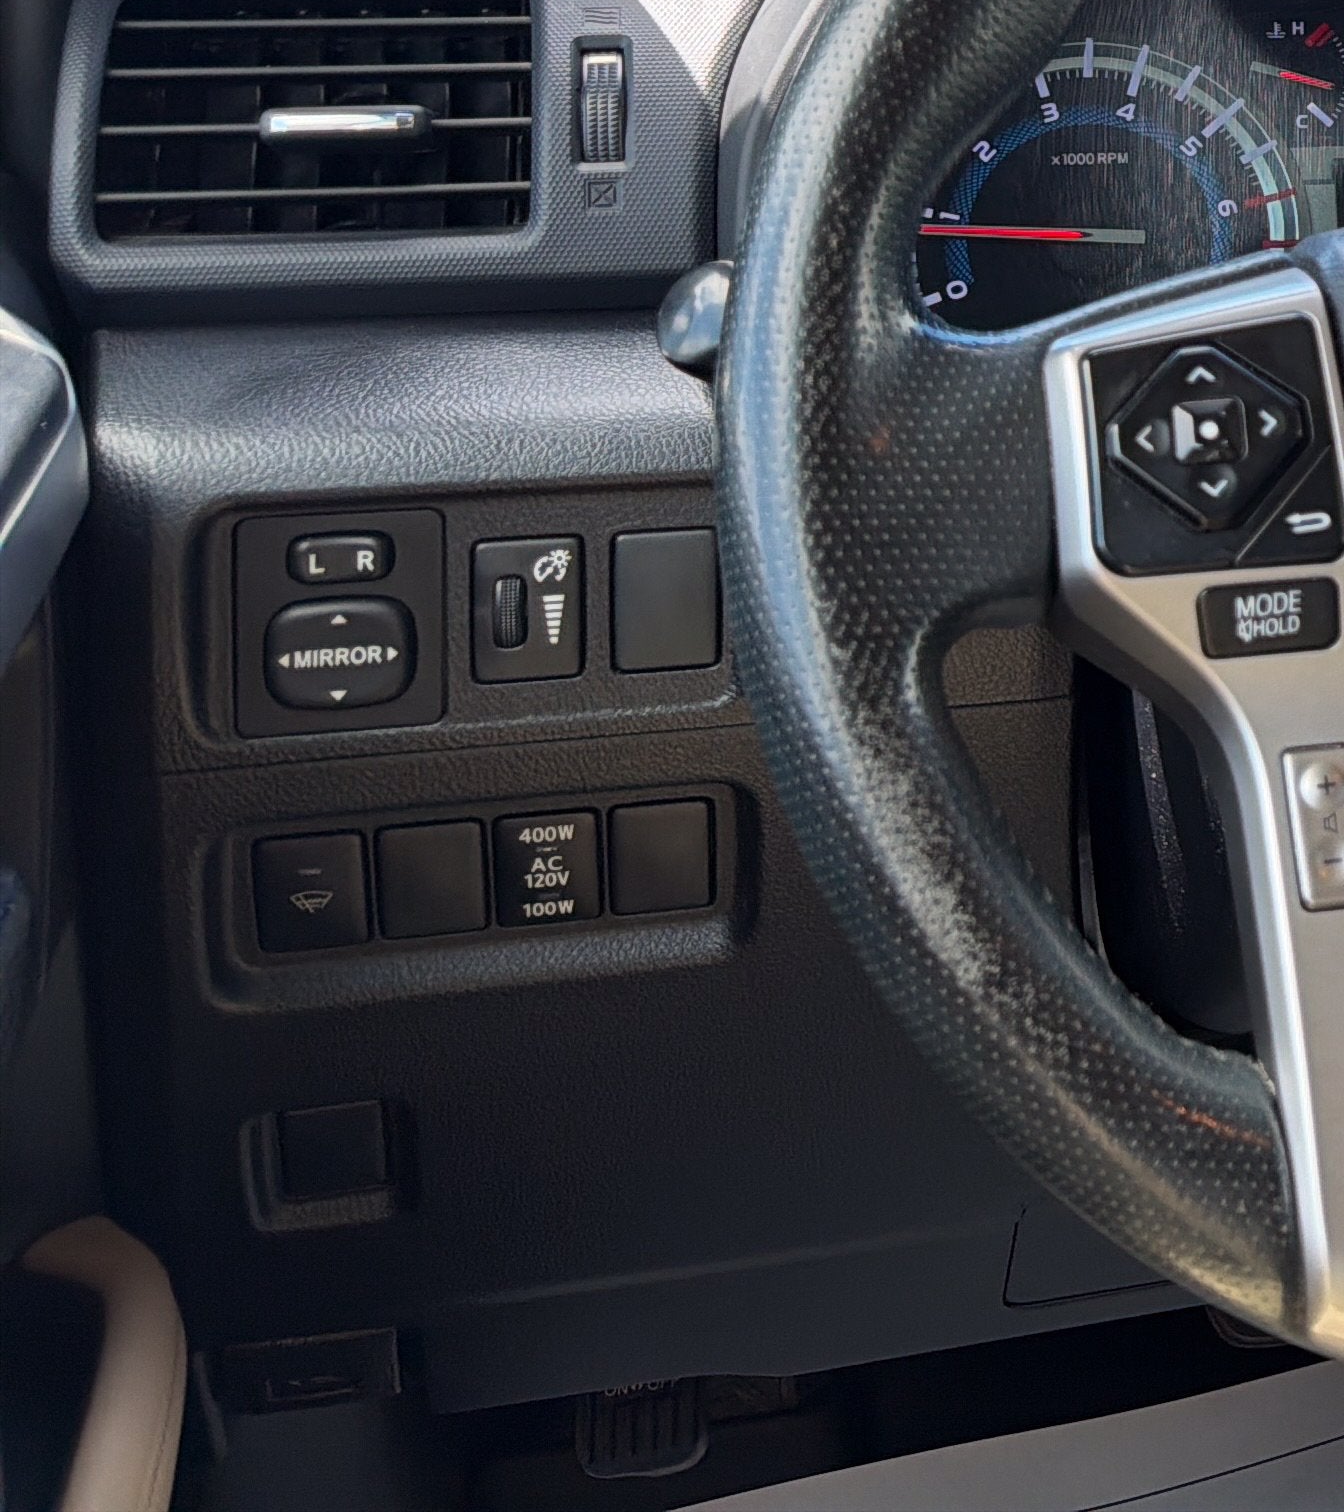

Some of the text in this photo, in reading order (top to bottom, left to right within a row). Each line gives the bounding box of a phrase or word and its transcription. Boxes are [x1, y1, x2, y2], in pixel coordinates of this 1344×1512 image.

[1292, 21, 1305, 35] H
[1040, 102, 1060, 123] 3
[1115, 102, 1136, 121] 4
[1296, 115, 1309, 129] C
[972, 140, 998, 163] 2
[1179, 135, 1203, 157] 5
[1097, 152, 1129, 164] RPM
[1217, 199, 1238, 217] 6
[946, 280, 968, 300] 0
[308, 550, 375, 575] L R
[1235, 589, 1302, 618] MODE
[1253, 615, 1301, 637] HOLD
[294, 645, 383, 669] MIRROR
[519, 824, 575, 844] 400W
[531, 856, 564, 873] AC
[524, 870, 570, 888] 120V
[523, 899, 575, 918] 100W
